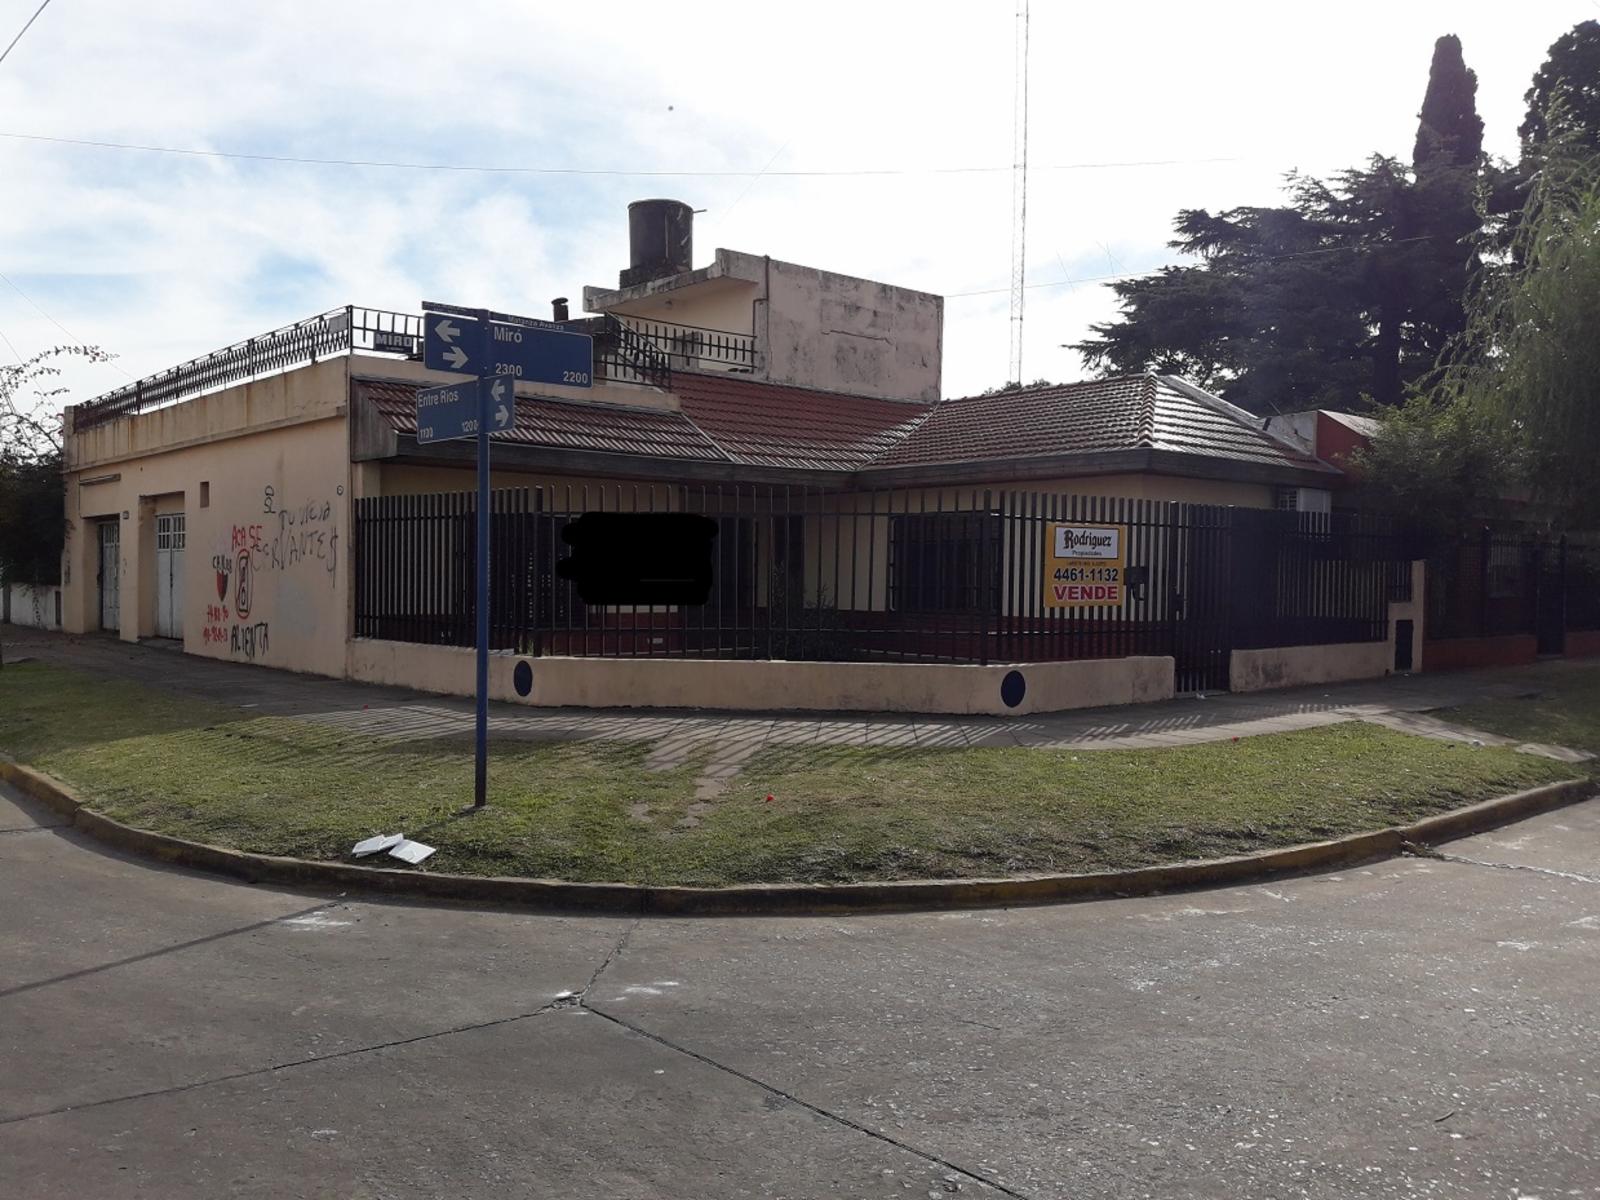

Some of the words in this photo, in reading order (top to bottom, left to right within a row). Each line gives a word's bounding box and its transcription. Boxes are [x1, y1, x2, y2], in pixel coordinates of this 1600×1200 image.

[494, 327, 523, 344] Miró
[495, 363, 523, 376] 2300
[563, 370, 589, 384] 2200
[418, 394, 439, 408] Entre
[1053, 567, 1119, 582] 4461-1132
[1053, 585, 1119, 601] VENDE
